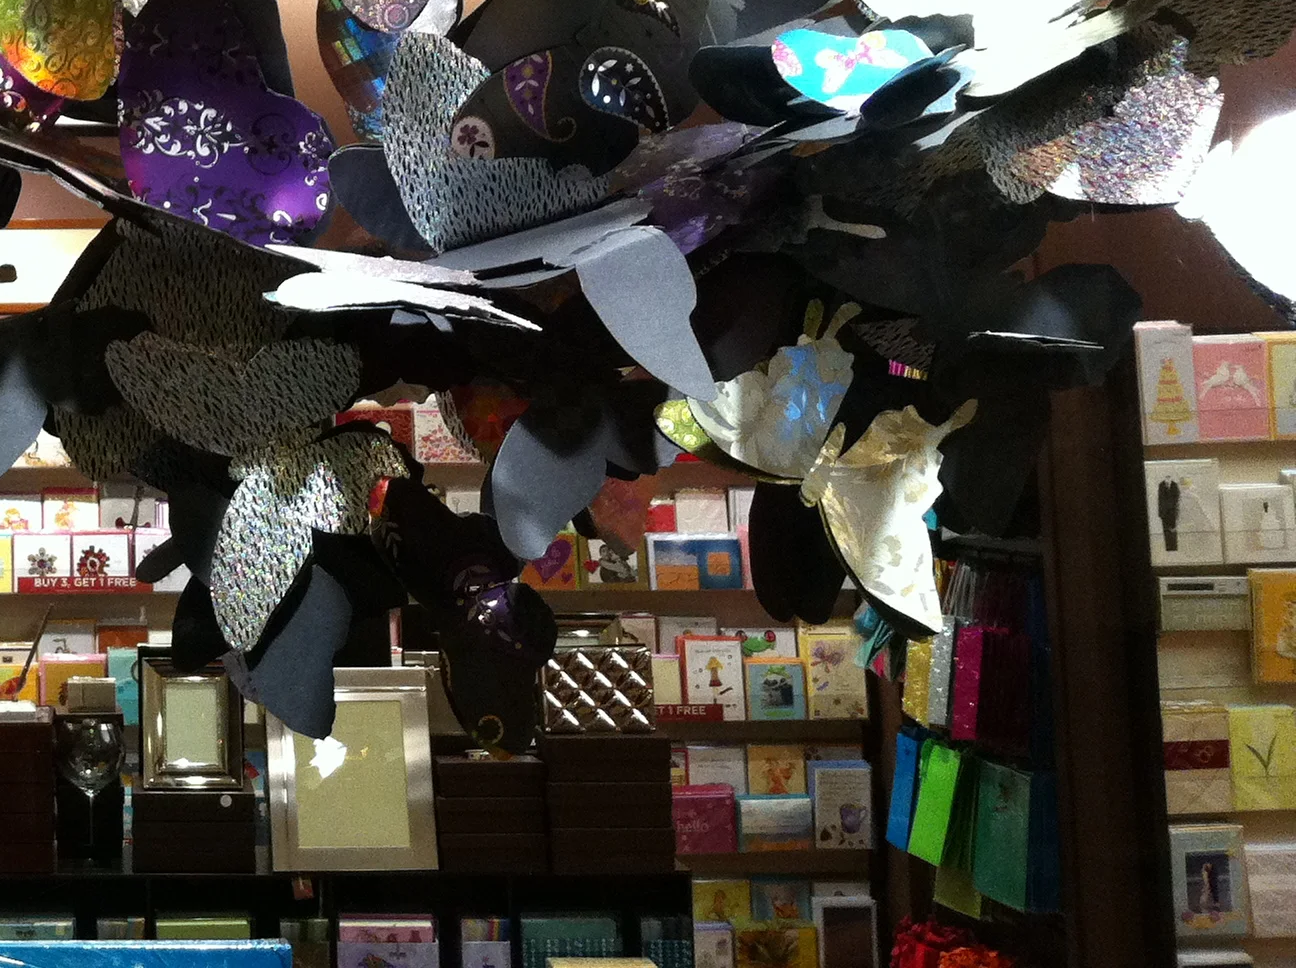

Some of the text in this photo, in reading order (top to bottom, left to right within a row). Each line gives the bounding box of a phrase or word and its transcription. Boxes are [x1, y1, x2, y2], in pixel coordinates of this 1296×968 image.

[33, 577, 58, 588] BUY
[73, 577, 97, 588] GET
[107, 577, 137, 588] FREE
[676, 705, 707, 715] FREE
[675, 819, 710, 833] hello
